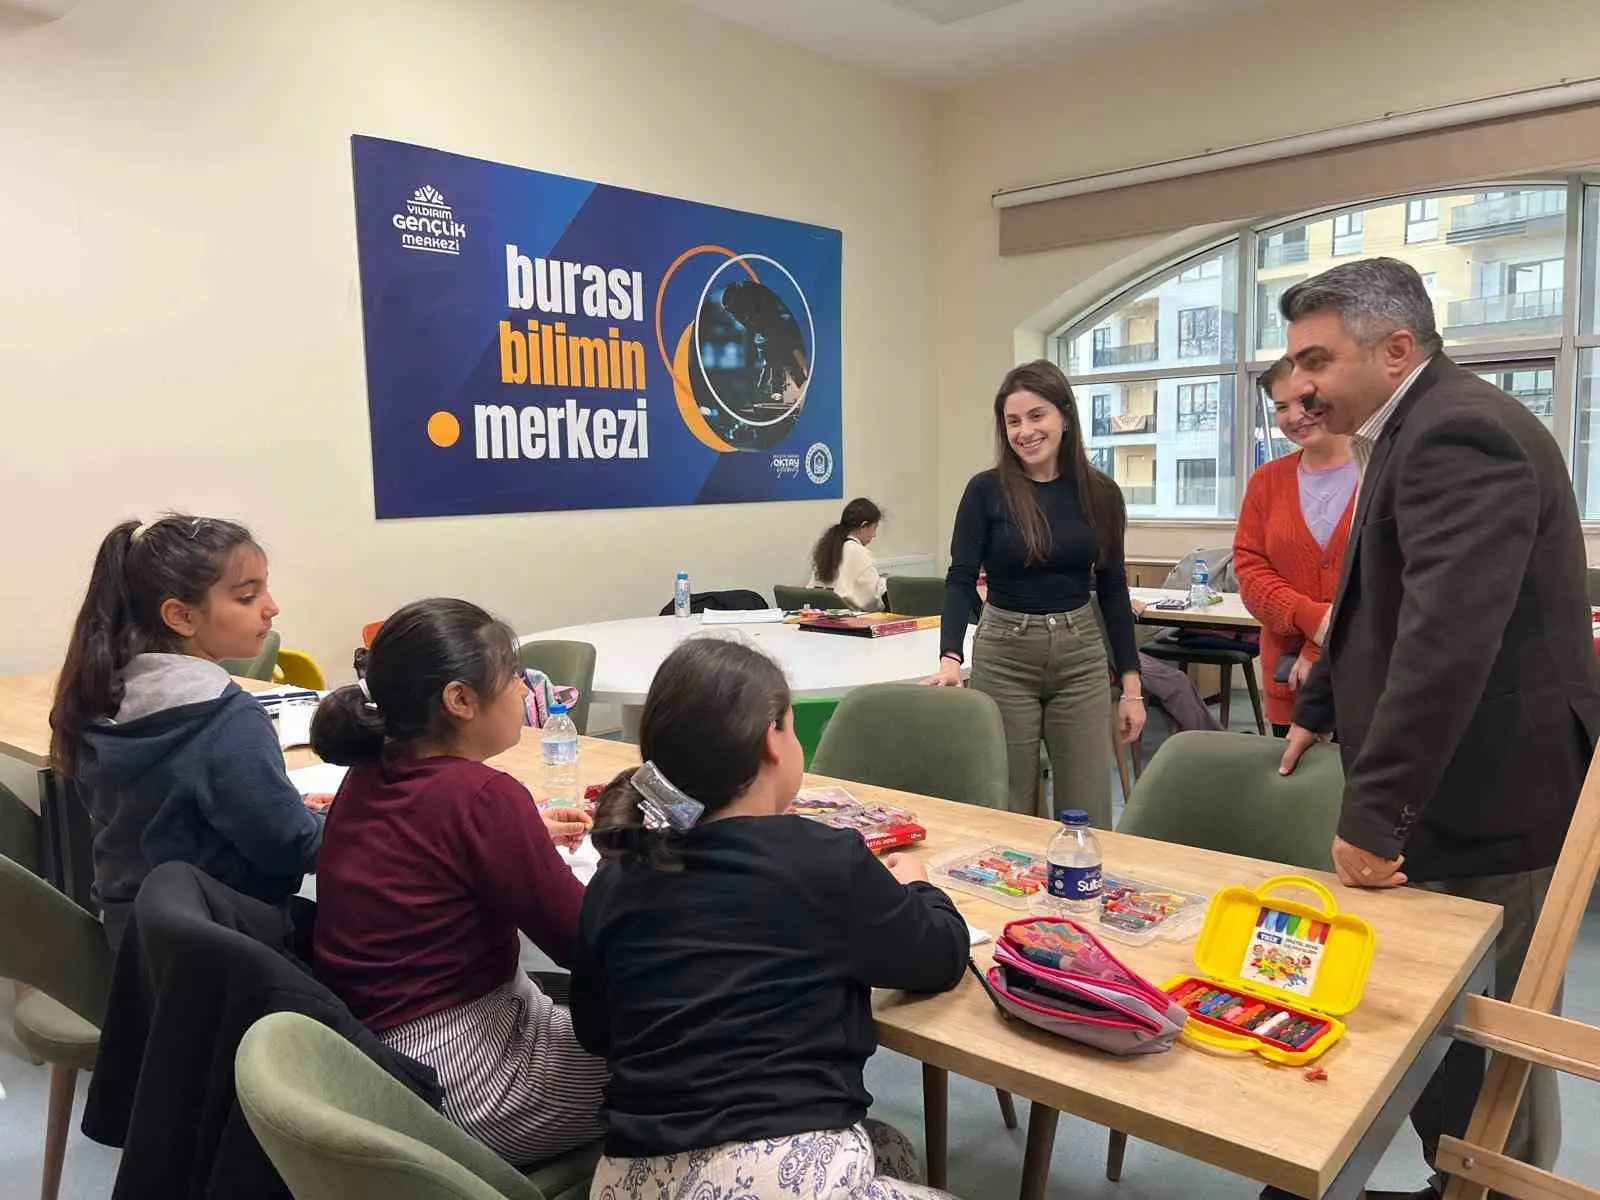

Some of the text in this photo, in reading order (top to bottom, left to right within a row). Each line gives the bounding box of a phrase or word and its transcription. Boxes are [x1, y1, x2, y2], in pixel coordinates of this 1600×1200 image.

[506, 244, 643, 321] burası
[499, 319, 646, 390] bilimin
[474, 398, 648, 459] merkezi
